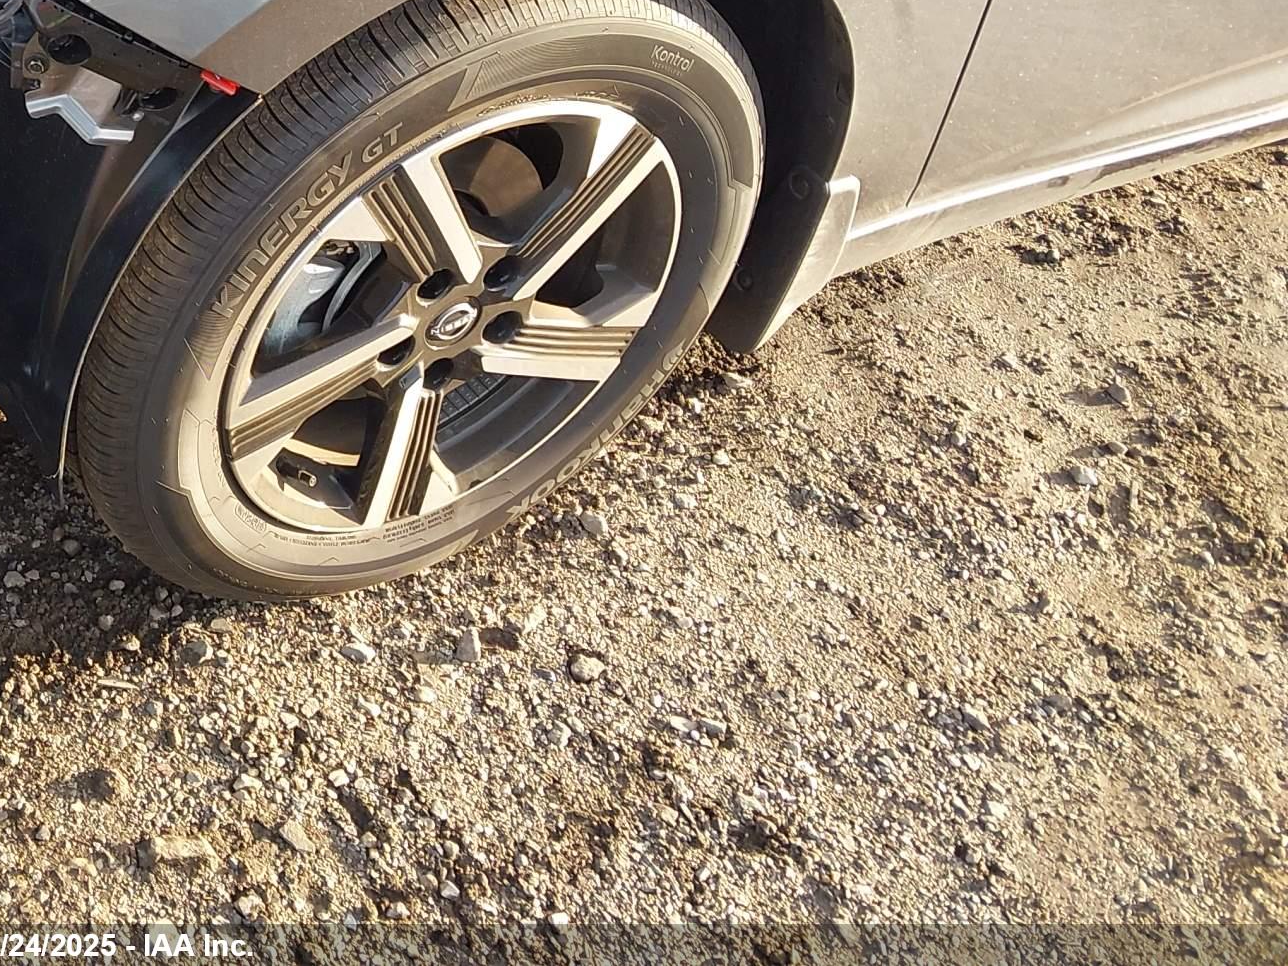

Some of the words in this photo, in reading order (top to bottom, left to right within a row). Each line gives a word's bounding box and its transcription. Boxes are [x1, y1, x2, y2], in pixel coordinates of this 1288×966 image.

[651, 44, 695, 73] Kontrol
[211, 151, 353, 319] KINERGY
[361, 122, 403, 164] GT
